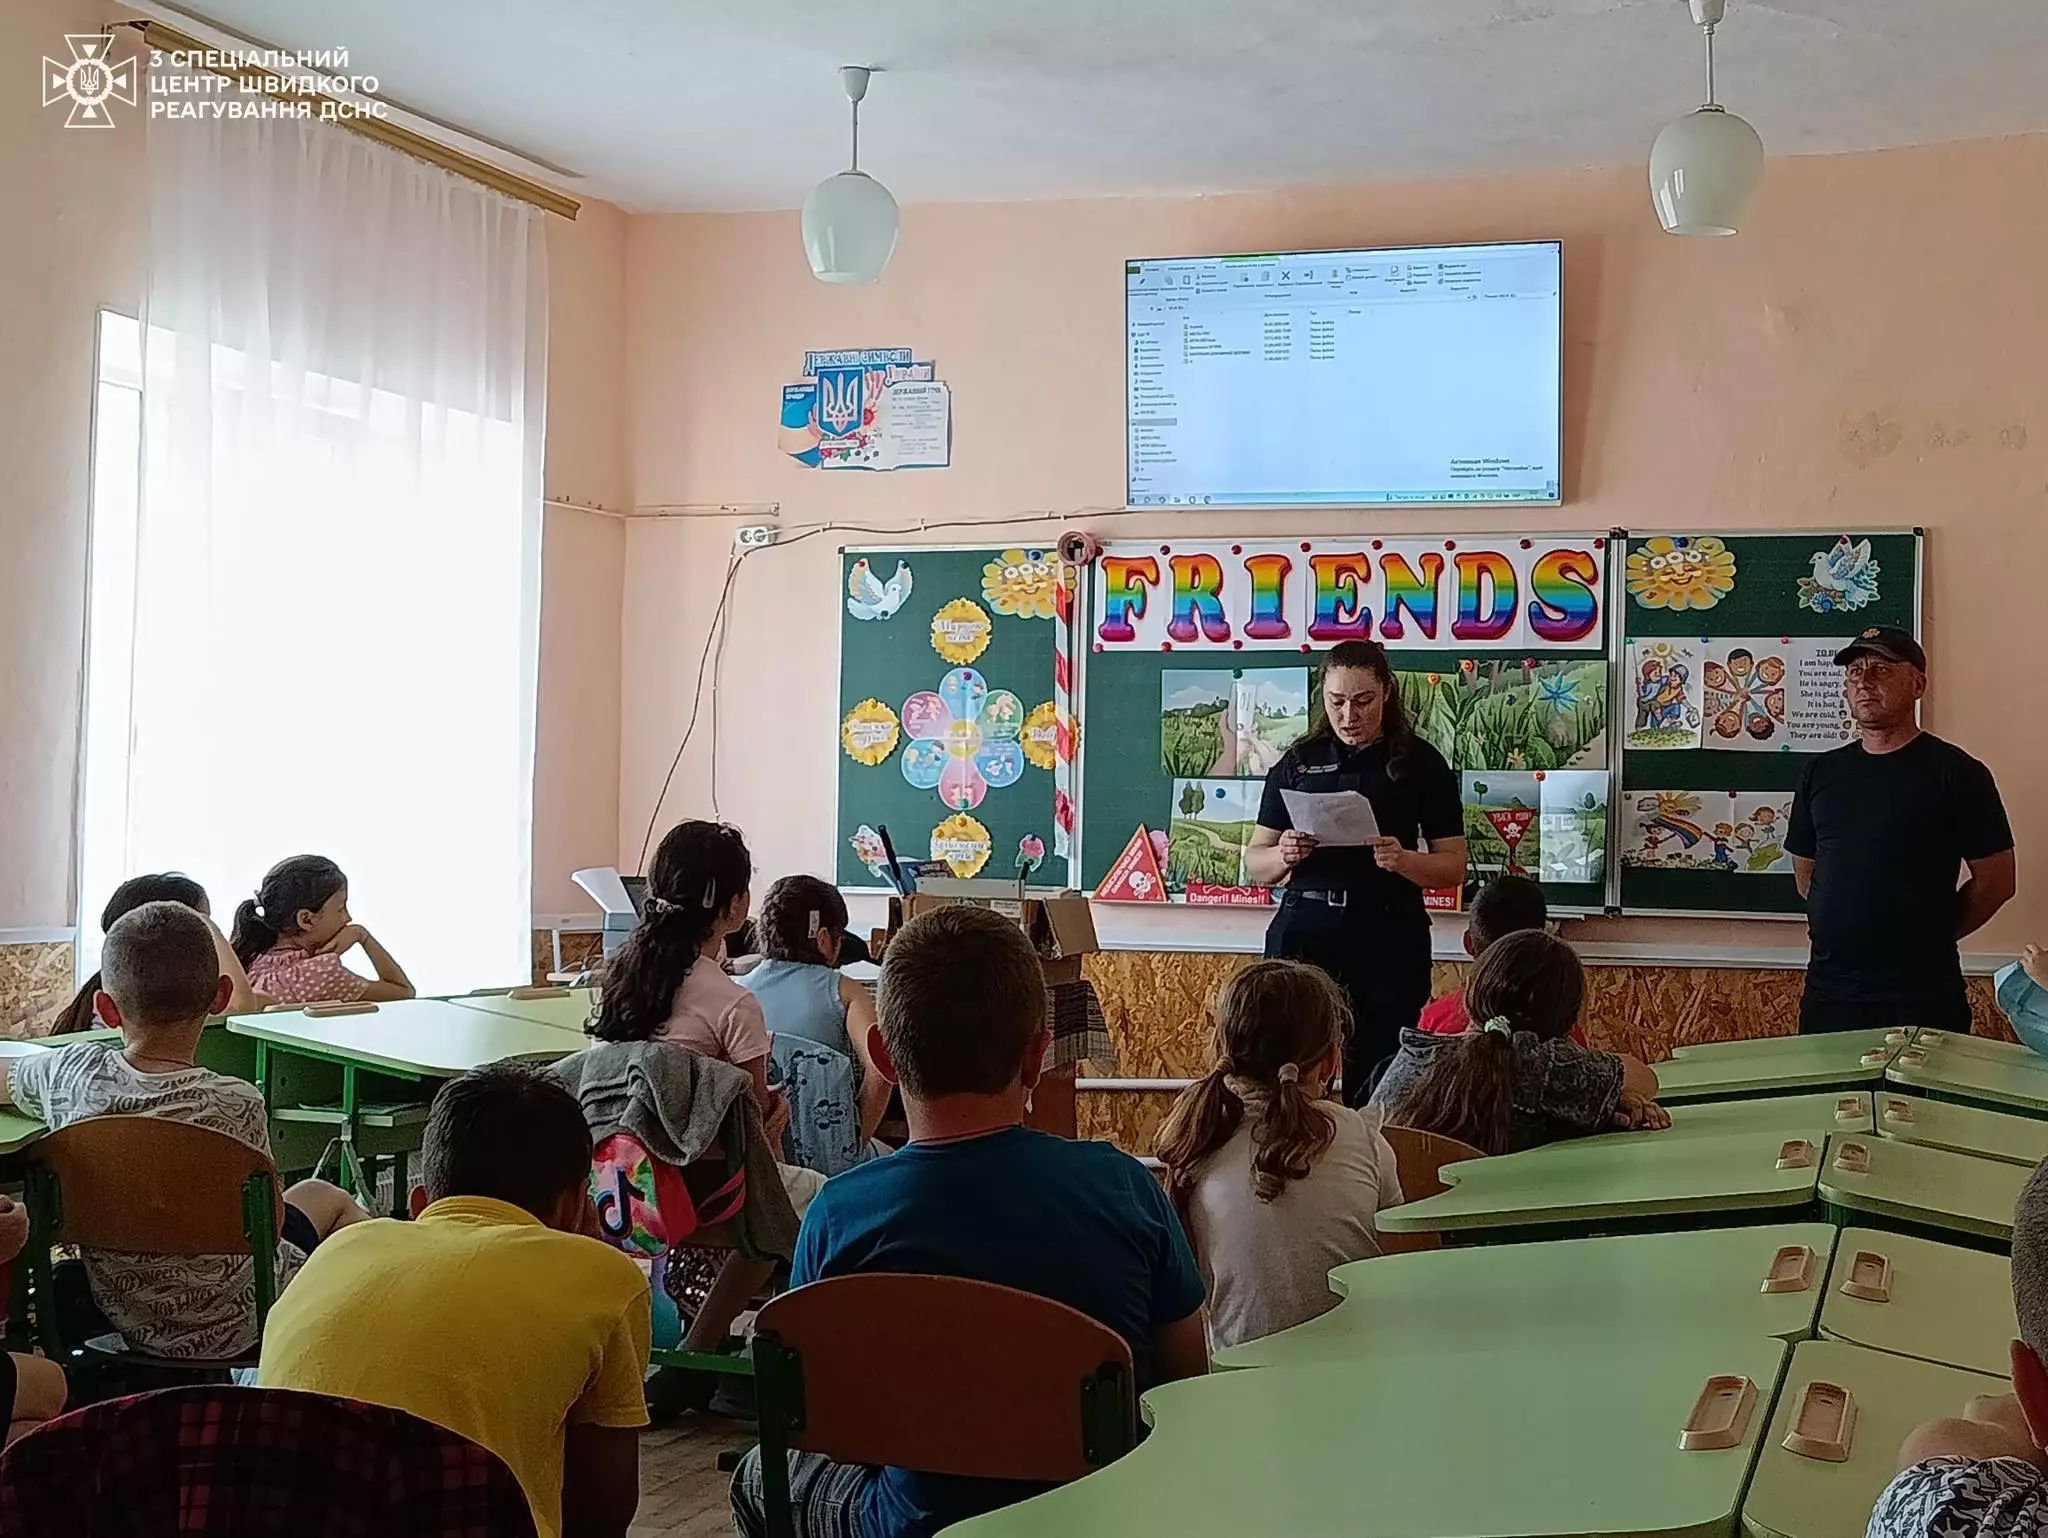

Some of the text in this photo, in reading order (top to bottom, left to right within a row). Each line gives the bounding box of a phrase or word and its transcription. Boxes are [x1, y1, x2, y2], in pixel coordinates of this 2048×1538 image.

[1098, 549, 1601, 642] FRIENDS
[1800, 690, 1813, 698] She
[1814, 690, 1822, 698] is
[1790, 731, 1807, 739] They
[1189, 893, 1265, 904] Danger!! Mines!!
